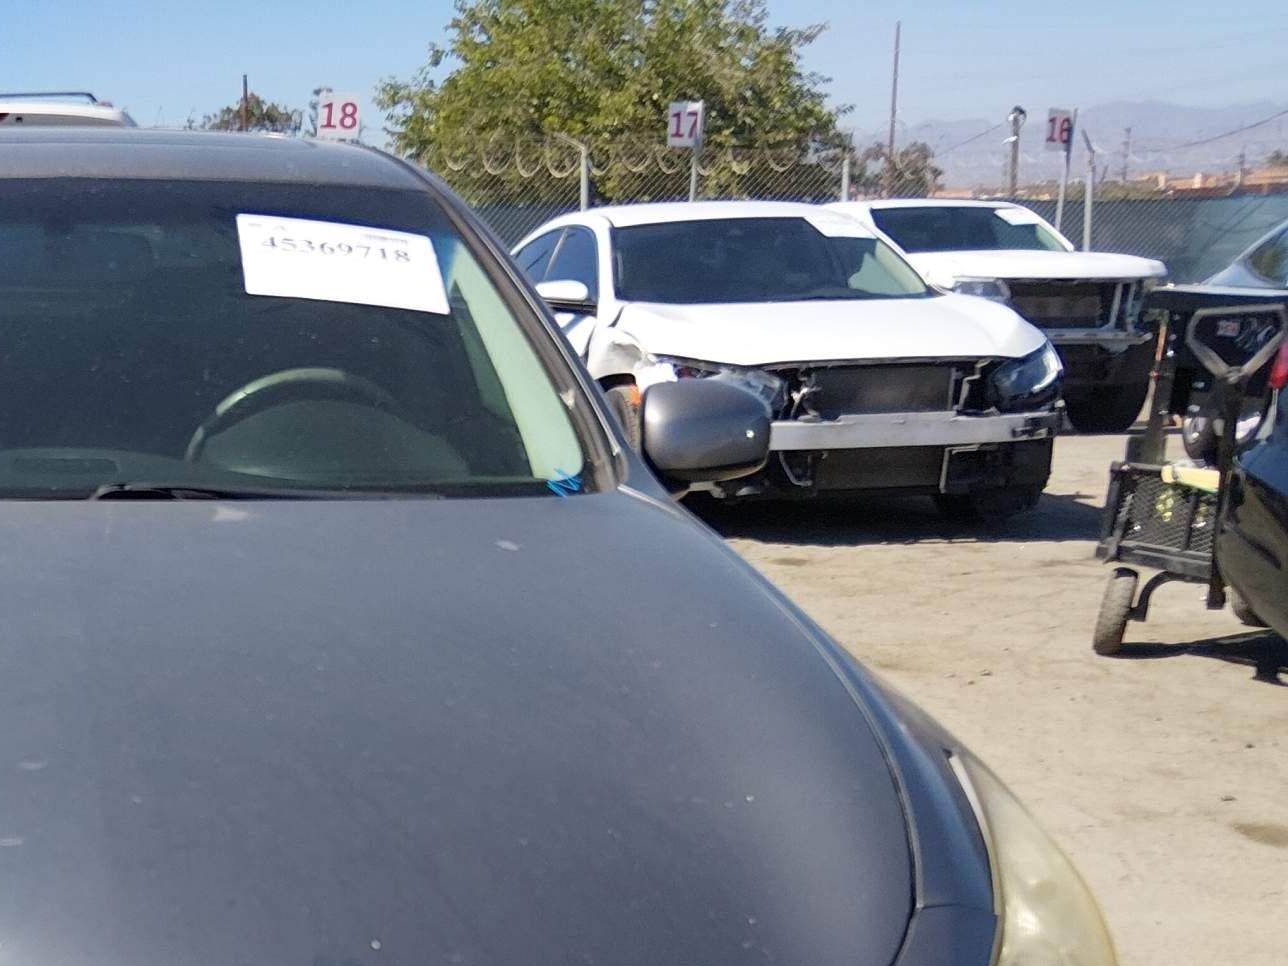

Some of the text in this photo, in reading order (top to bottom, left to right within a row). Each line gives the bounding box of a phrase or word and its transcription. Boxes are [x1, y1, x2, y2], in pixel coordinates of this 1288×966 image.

[320, 102, 357, 129] 18
[671, 111, 699, 138] 17
[261, 236, 410, 263] 45369718
